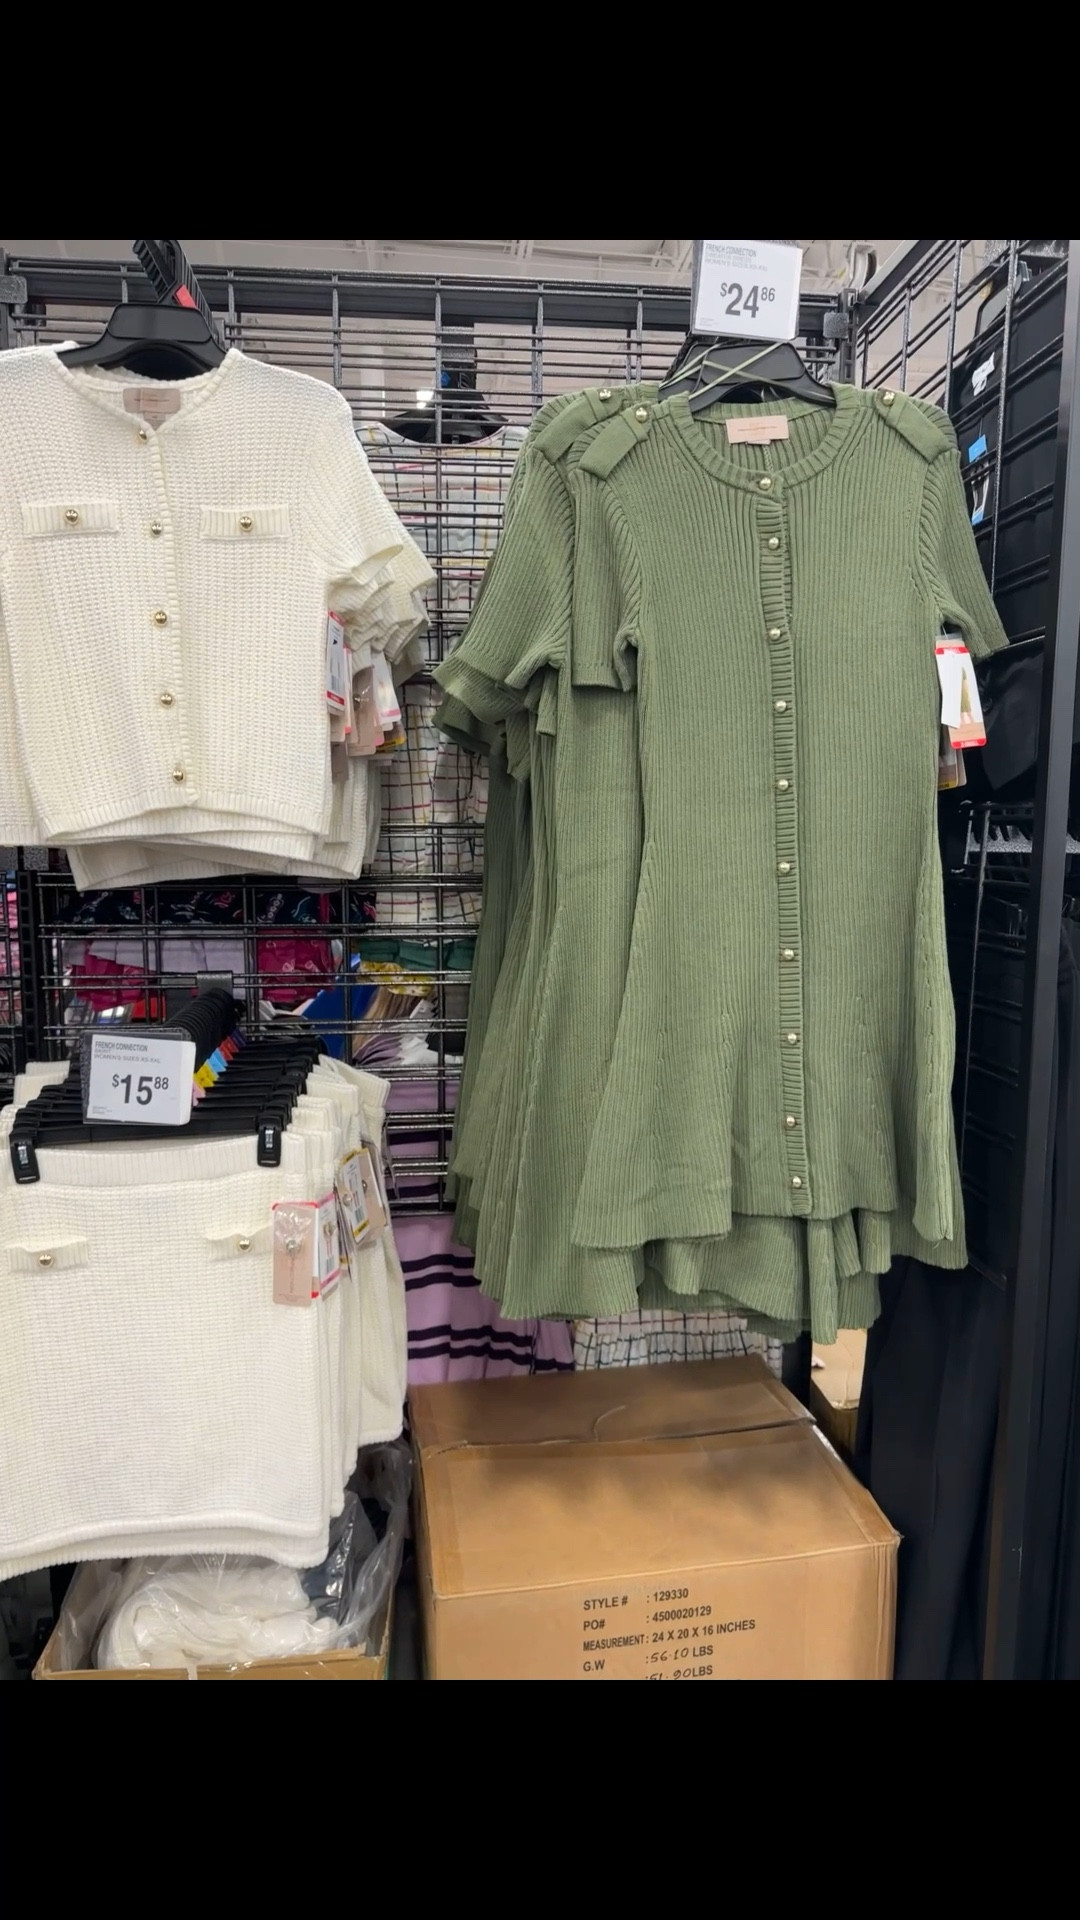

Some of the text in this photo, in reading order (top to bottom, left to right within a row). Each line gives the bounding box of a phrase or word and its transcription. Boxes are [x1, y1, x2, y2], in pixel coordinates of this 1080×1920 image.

[705, 243, 757, 257] FRENCH CONNECTION
[95, 1041, 148, 1052] FRENCH CONNECTION
[583, 1596, 619, 1610] STYLE
[653, 1588, 689, 1602] 129330
[583, 1619, 605, 1631] PO#
[652, 1606, 712, 1622] 4500020129
[652, 1633, 664, 1643] 24
[667, 1631, 674, 1641] X
[677, 1629, 689, 1639] 20
[692, 1628, 699, 1637] X
[702, 1626, 713, 1636] 16
[716, 1619, 756, 1634] INCHES
[583, 1659, 605, 1672] G.W
[692, 1645, 713, 1657] LBS
[692, 1665, 713, 1677] LBS
